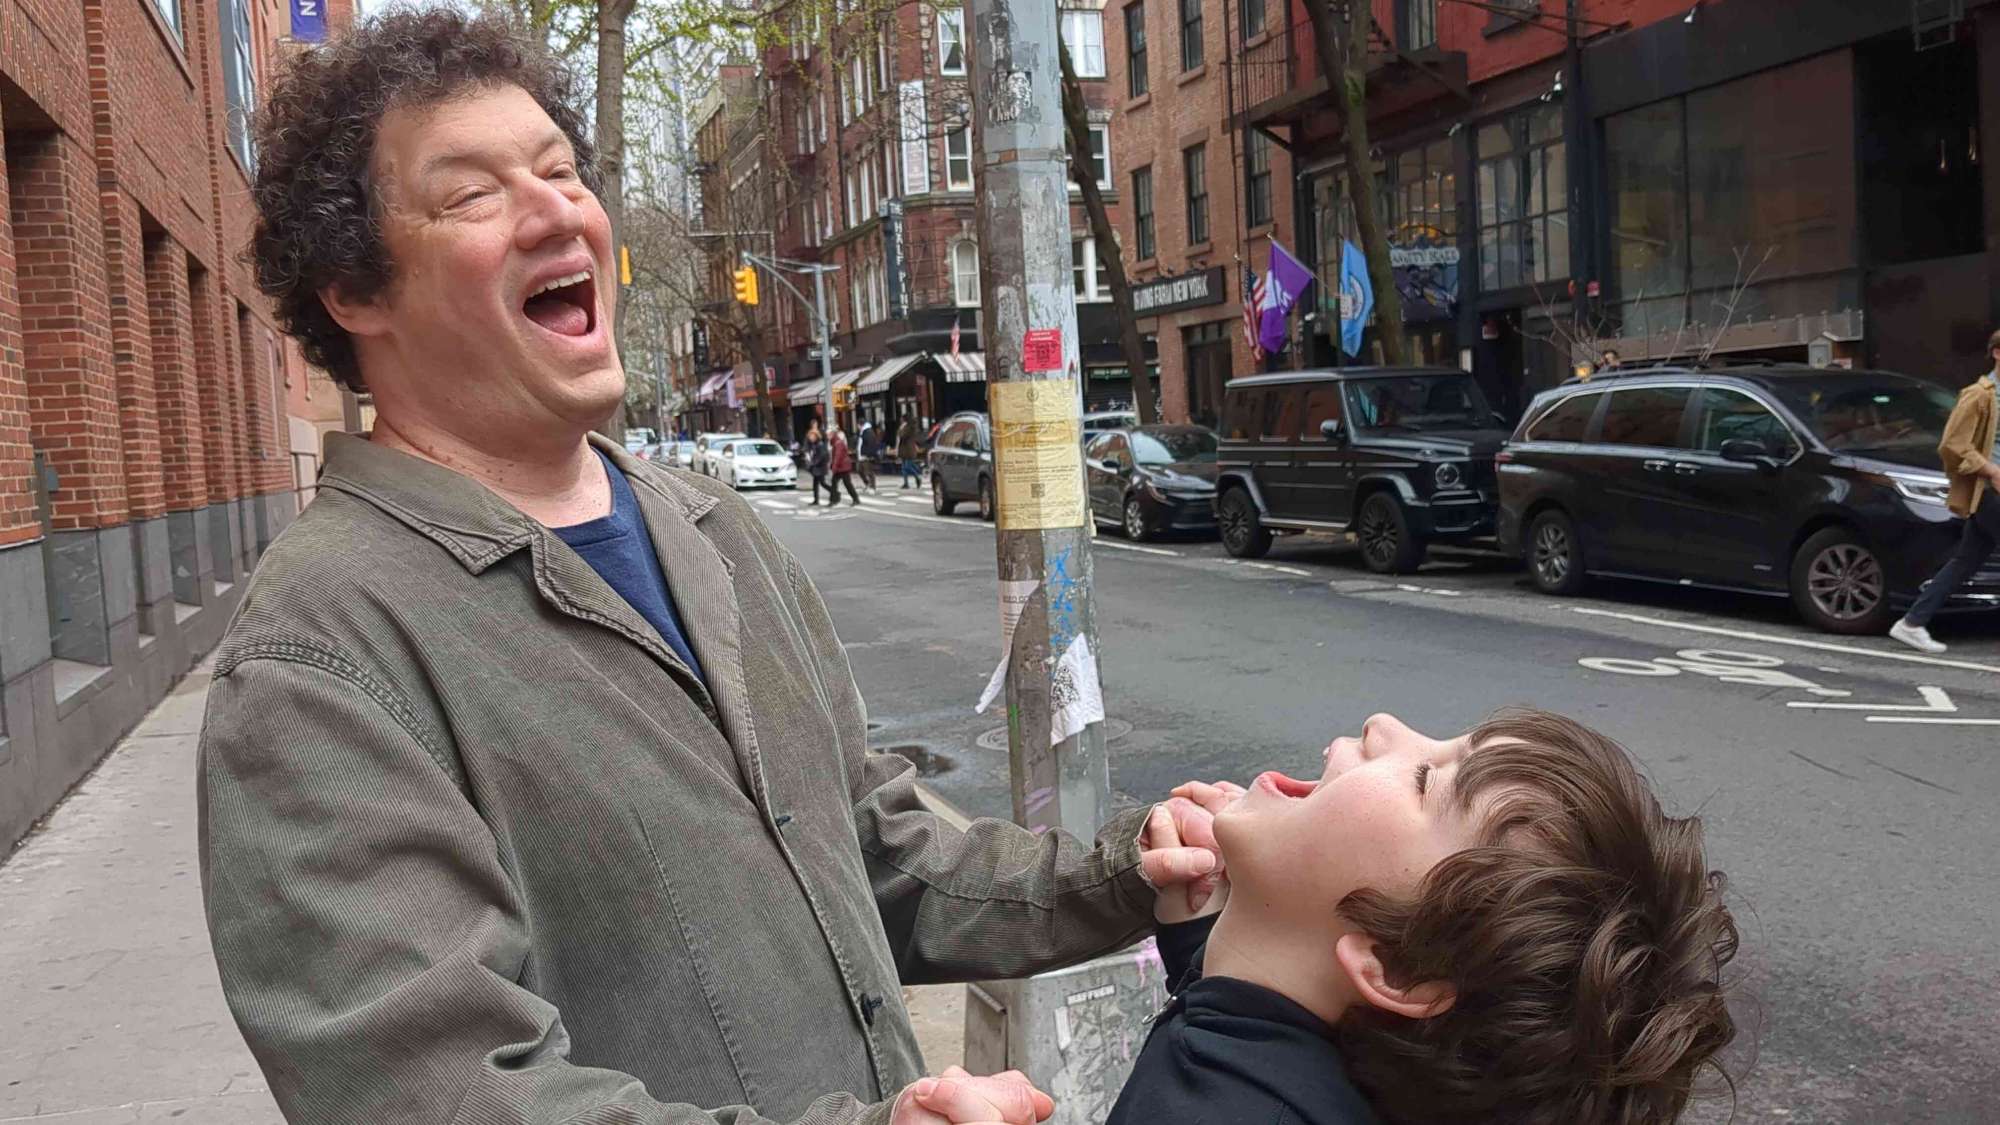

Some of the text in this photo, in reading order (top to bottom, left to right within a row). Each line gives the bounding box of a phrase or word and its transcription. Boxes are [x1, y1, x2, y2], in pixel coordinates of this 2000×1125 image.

[894, 221, 904, 266] HALF
[899, 271, 909, 316] PINT
[1154, 284, 1173, 306] FARM
[1172, 280, 1188, 303] NEW
[1188, 275, 1208, 299] YORK
